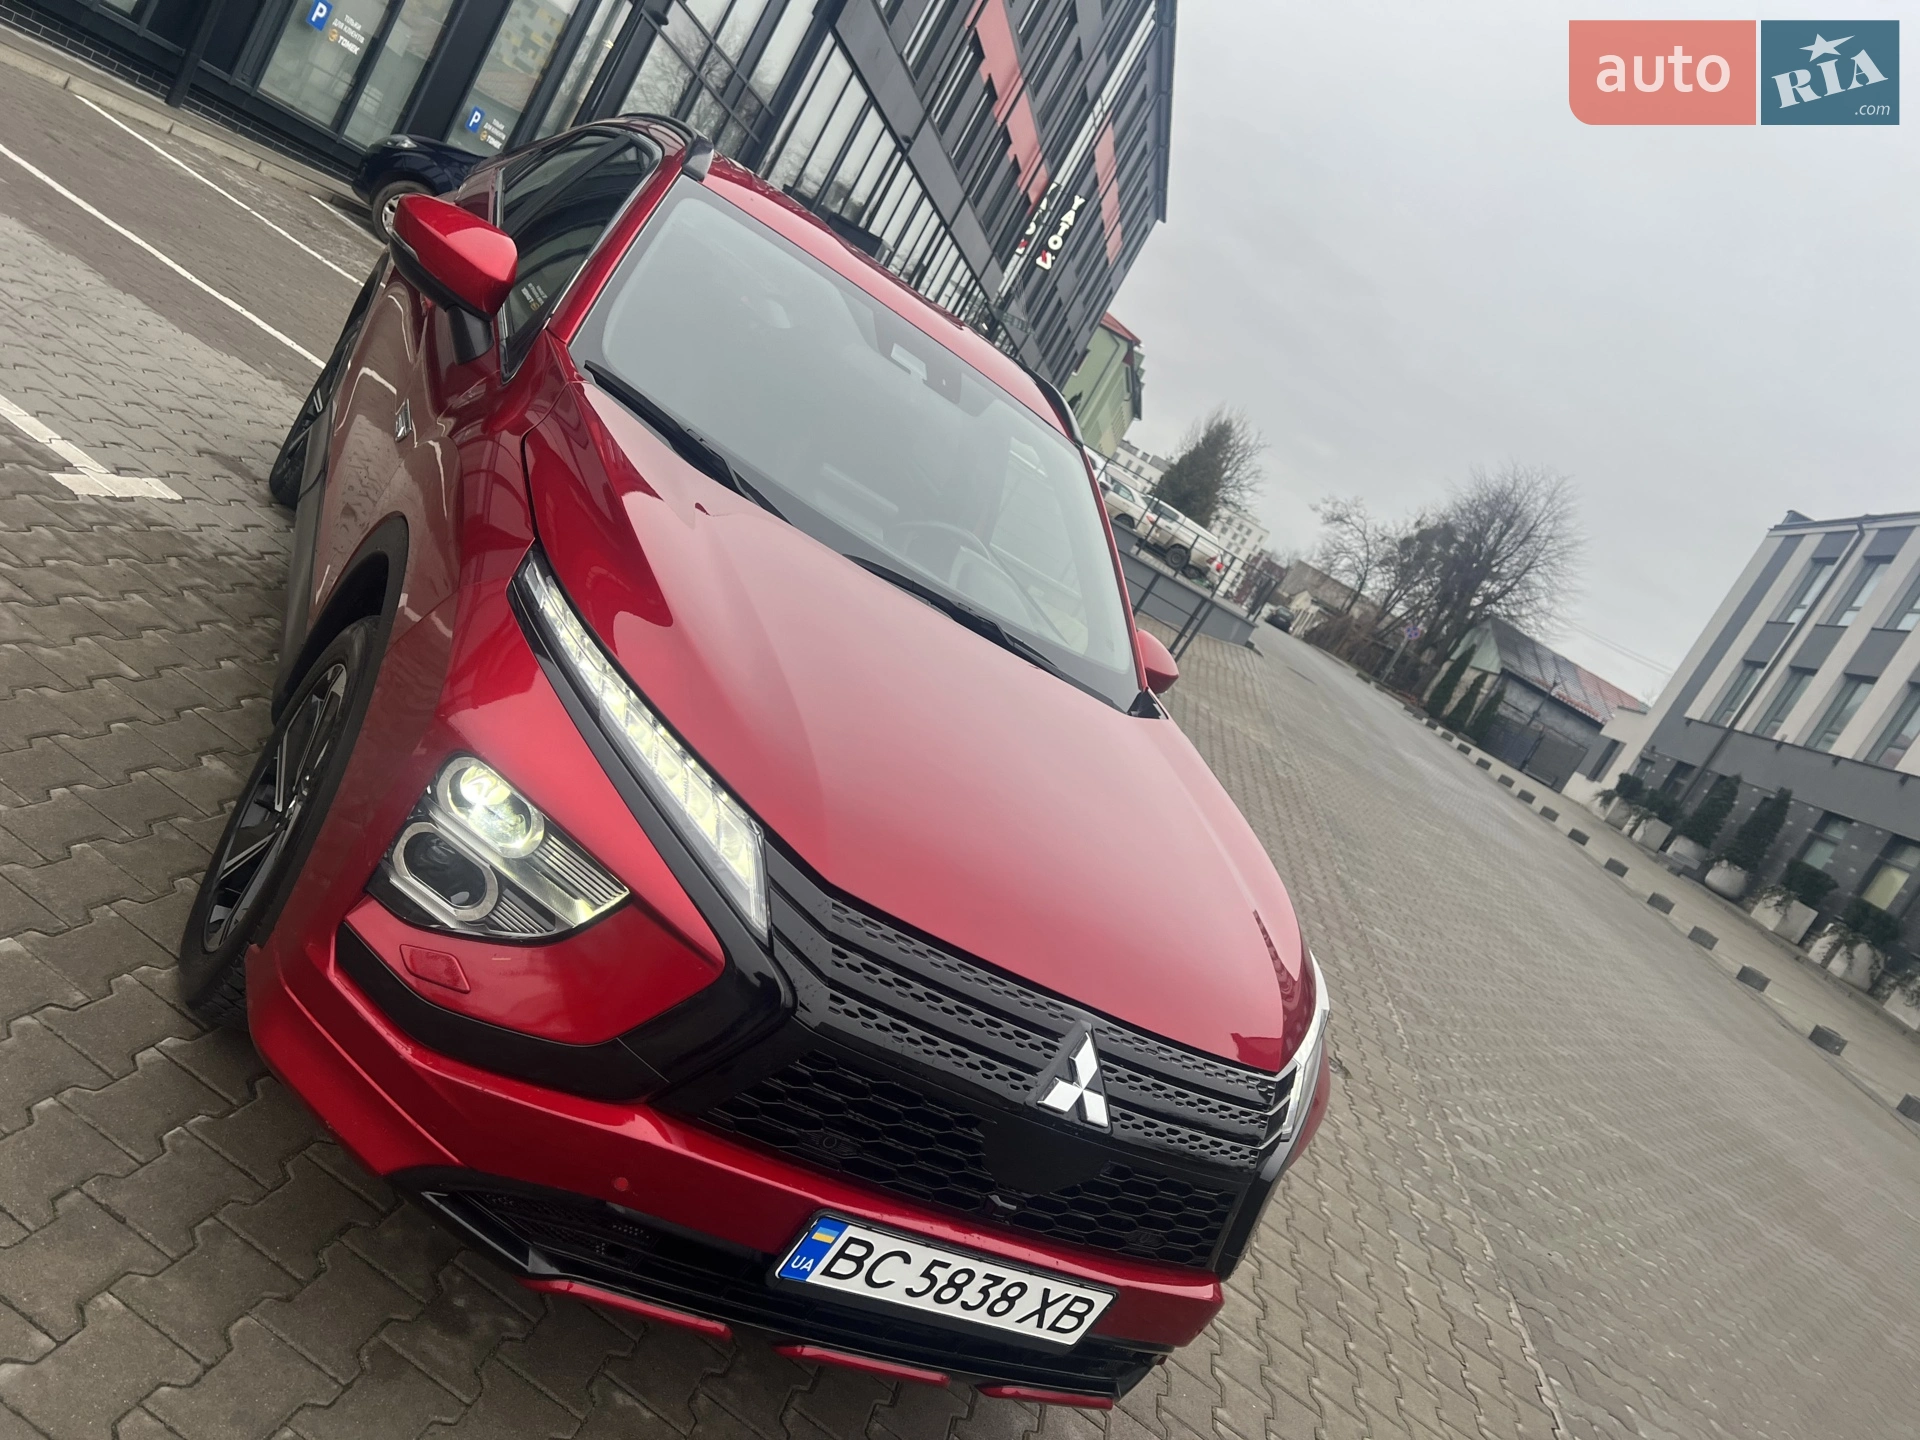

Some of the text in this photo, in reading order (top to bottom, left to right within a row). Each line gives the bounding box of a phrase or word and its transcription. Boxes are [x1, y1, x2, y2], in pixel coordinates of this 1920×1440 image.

[1047, 194, 1086, 250] YATO
[790, 1255, 815, 1273] UA
[820, 1236, 1095, 1335] BC 5838 XB
